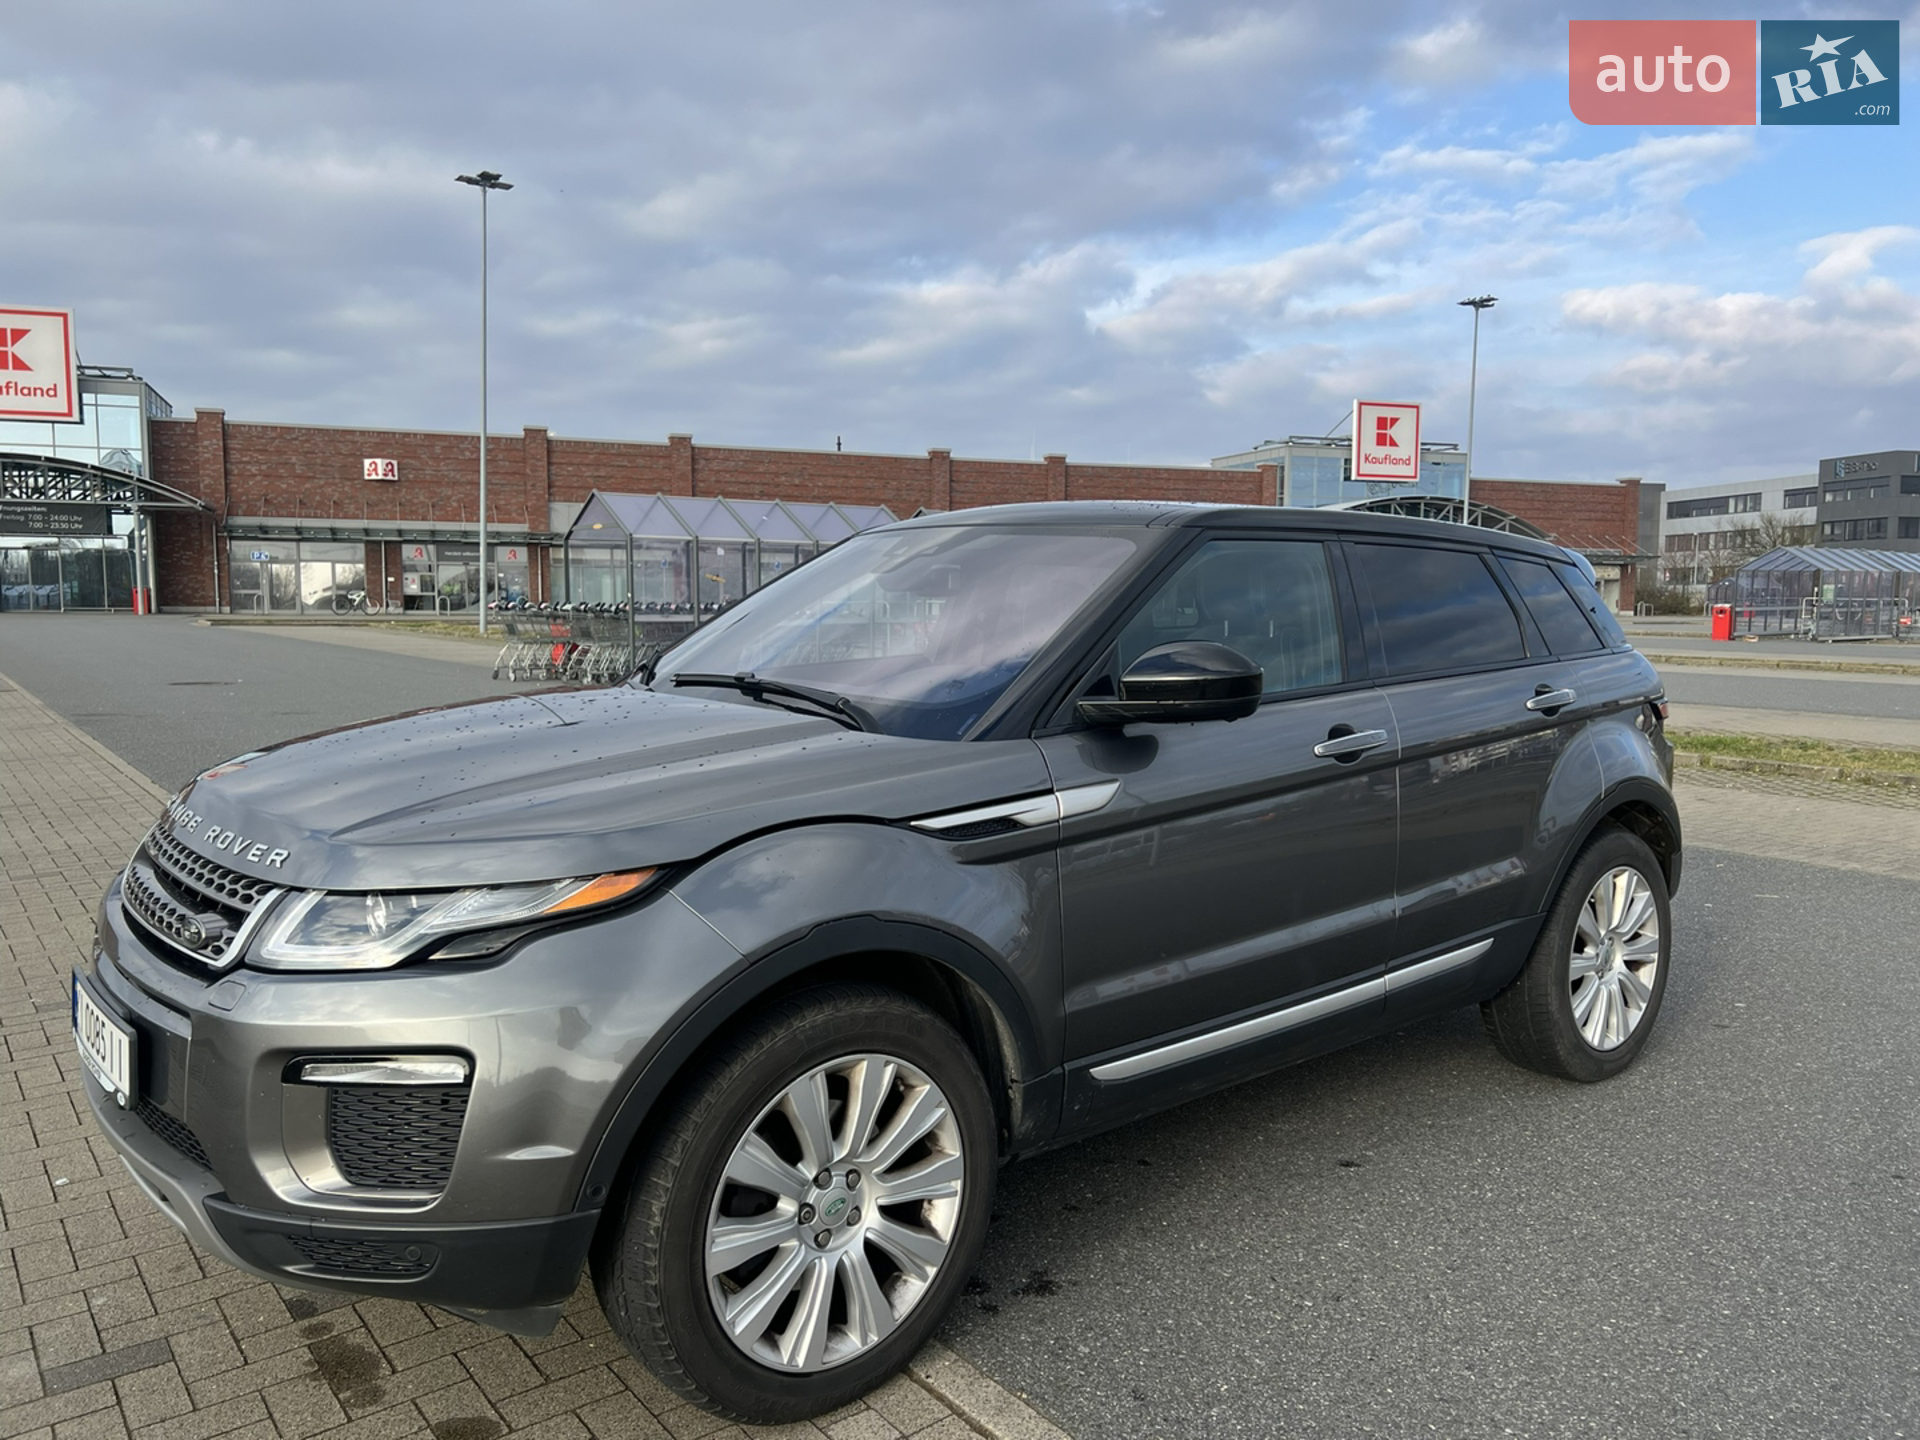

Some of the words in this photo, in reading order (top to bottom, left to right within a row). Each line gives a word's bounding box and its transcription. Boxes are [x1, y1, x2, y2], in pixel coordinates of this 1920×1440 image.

[1364, 453, 1411, 466] Kaufland
[203, 824, 290, 868] ROVER
[85, 1002, 107, 1063] 0085
